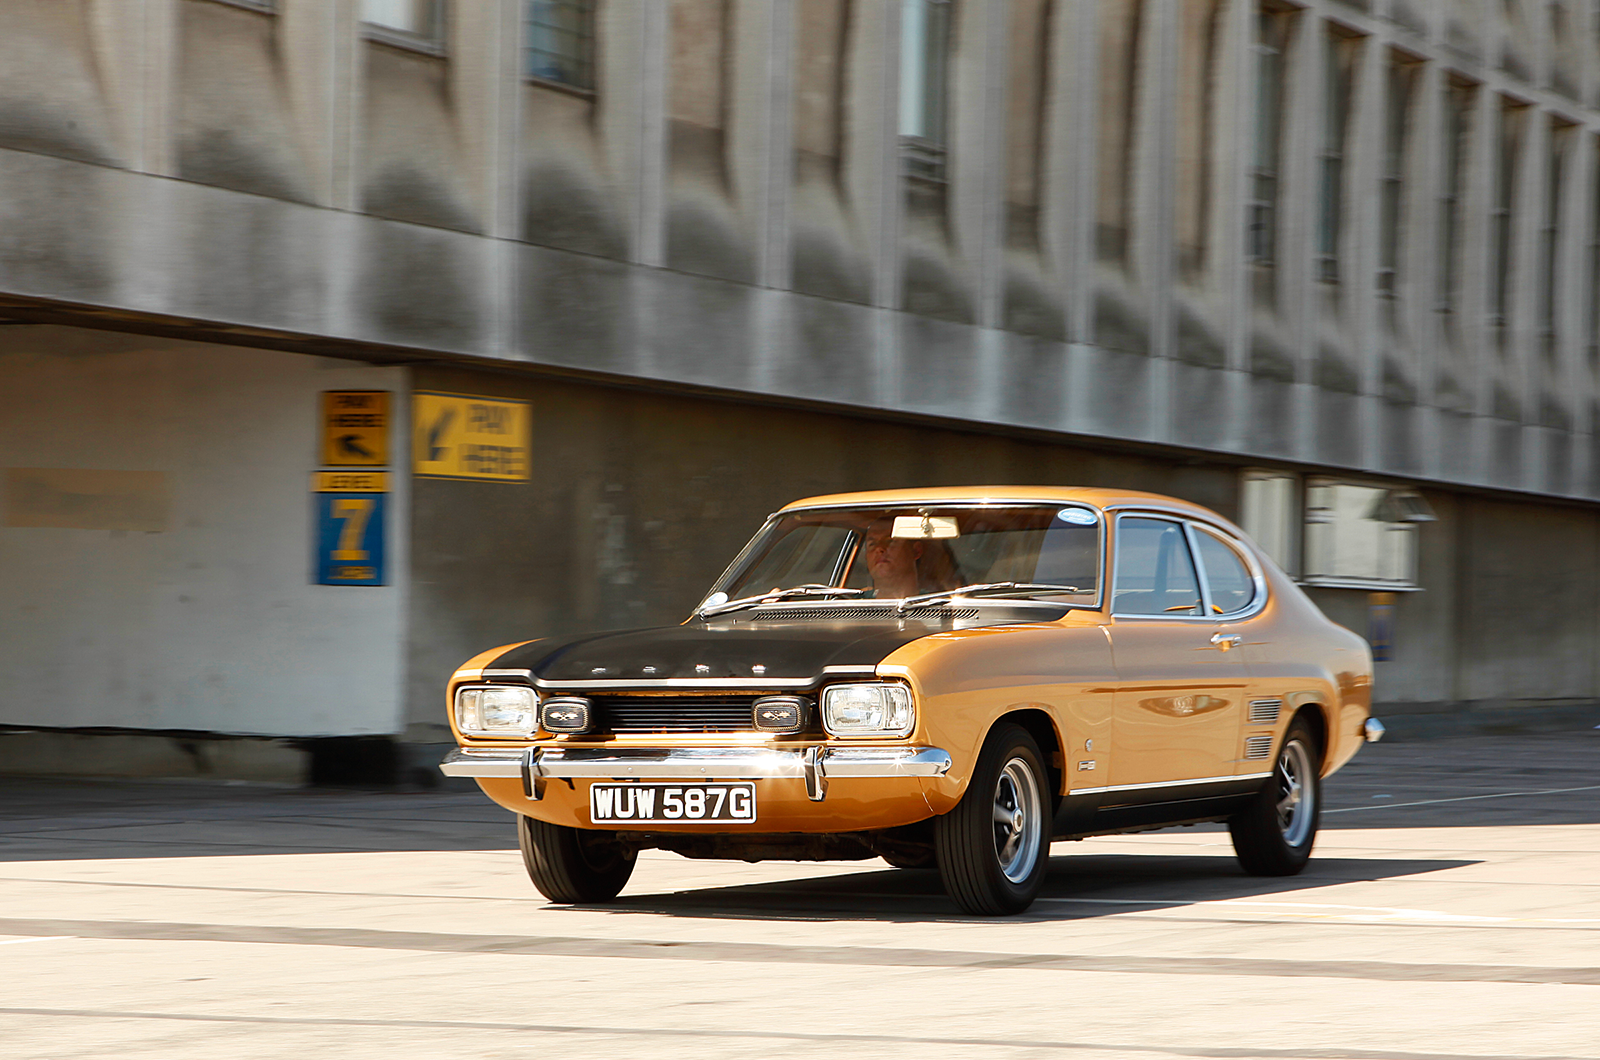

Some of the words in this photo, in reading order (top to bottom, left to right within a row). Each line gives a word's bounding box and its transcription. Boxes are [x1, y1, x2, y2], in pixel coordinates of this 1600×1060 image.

[330, 499, 376, 560] 7
[595, 788, 656, 819] WUW
[663, 787, 751, 819] 587G
